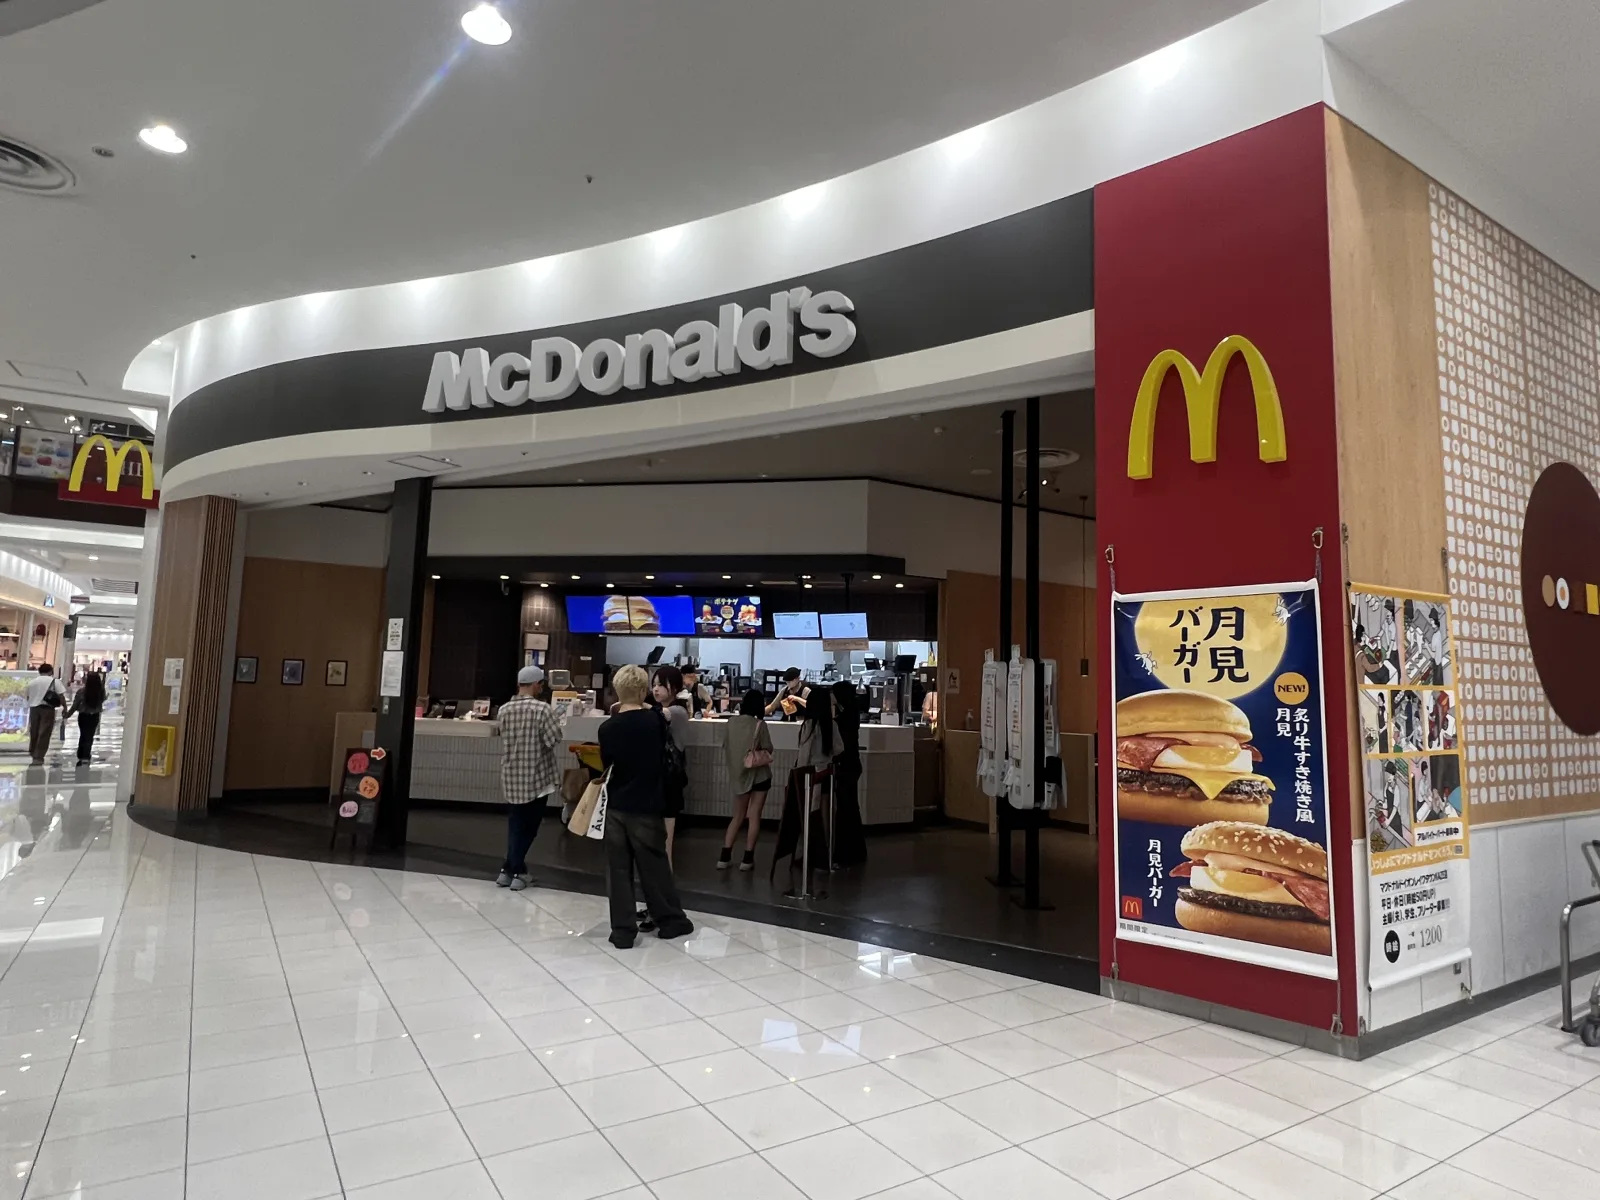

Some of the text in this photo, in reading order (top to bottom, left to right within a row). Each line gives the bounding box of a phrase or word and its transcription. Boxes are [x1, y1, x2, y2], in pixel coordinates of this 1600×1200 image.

[422, 286, 857, 413] McDonald's
[1169, 606, 1203, 683] バーガー
[1203, 606, 1249, 683] 月見
[1275, 708, 1292, 737] 月見
[1277, 684, 1306, 693] NEW!
[1293, 708, 1315, 823] 炙り牛すき焼き風
[1147, 839, 1163, 907] 月見バーガー
[1420, 924, 1442, 947] 1200
